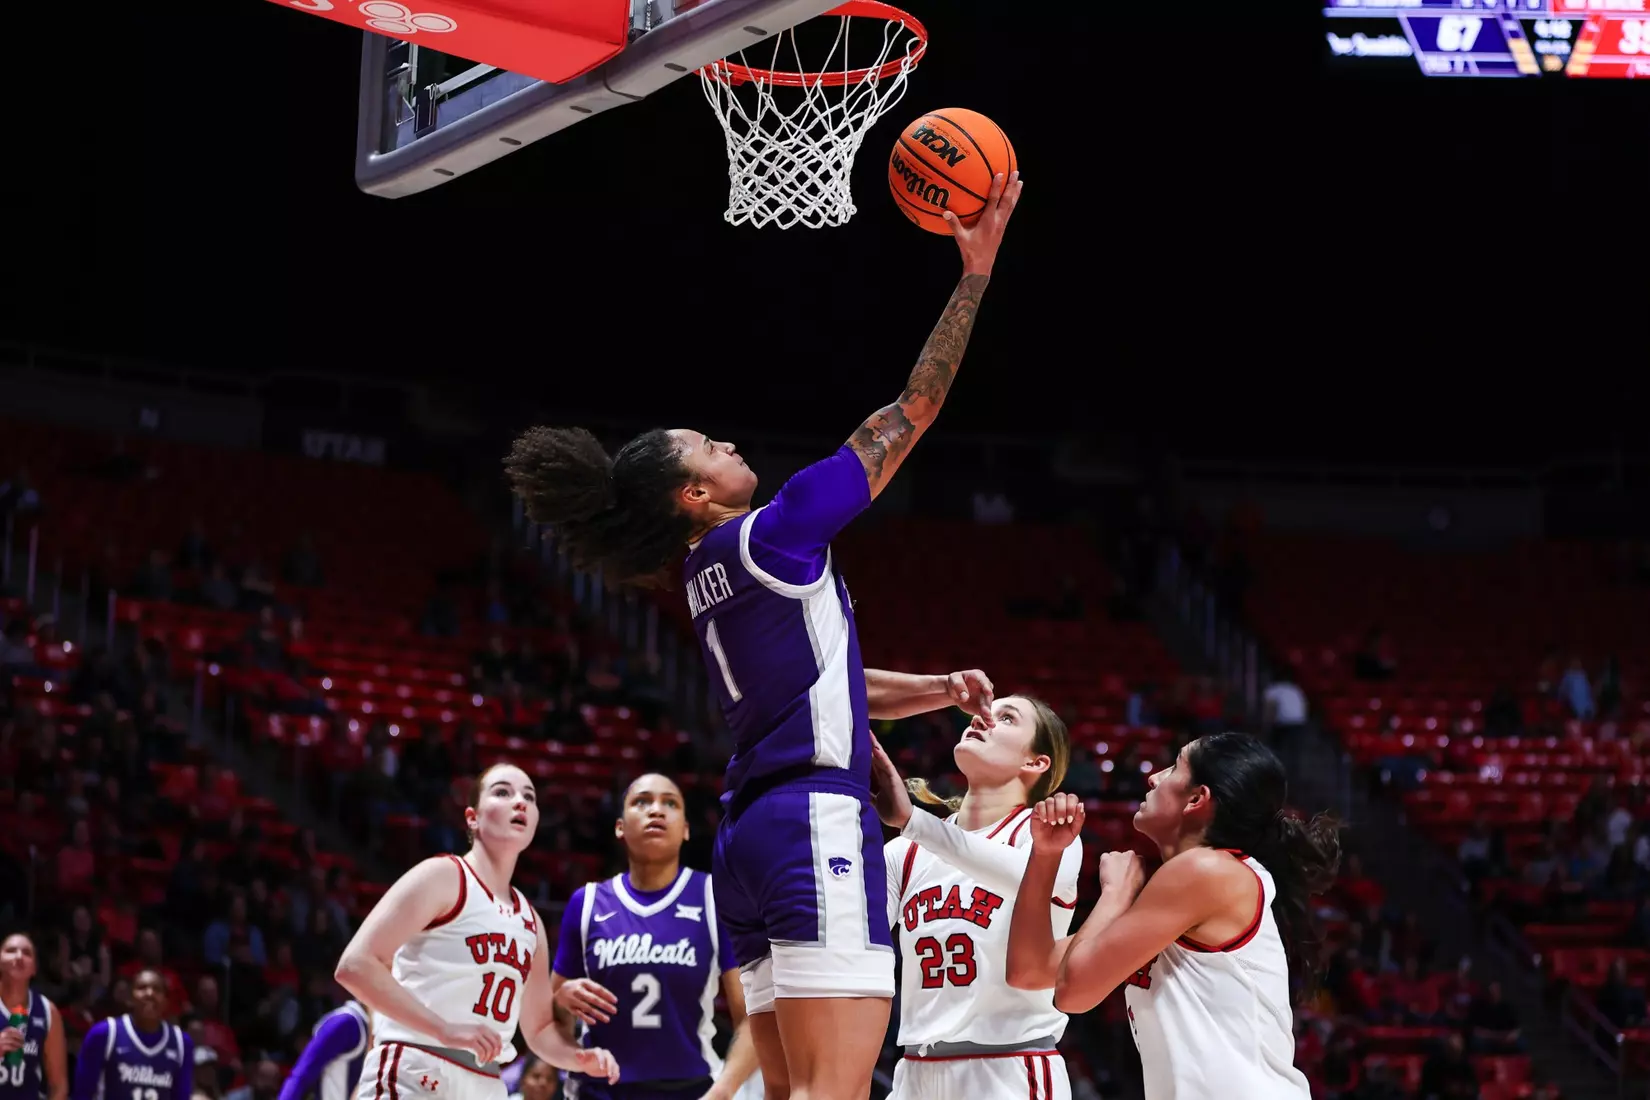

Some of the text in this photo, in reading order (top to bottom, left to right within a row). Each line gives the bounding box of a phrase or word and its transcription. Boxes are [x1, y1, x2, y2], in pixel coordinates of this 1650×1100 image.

[1436, 15, 1482, 51] 67
[912, 124, 967, 168] NCAA
[891, 149, 949, 209] Wilson
[301, 430, 387, 464] UTAH
[705, 617, 743, 703] 1
[903, 884, 1004, 932] UTAH
[593, 933, 698, 970] Wildcats
[915, 932, 977, 989] 23
[472, 971, 516, 1023] 10
[631, 972, 662, 1029] 2
